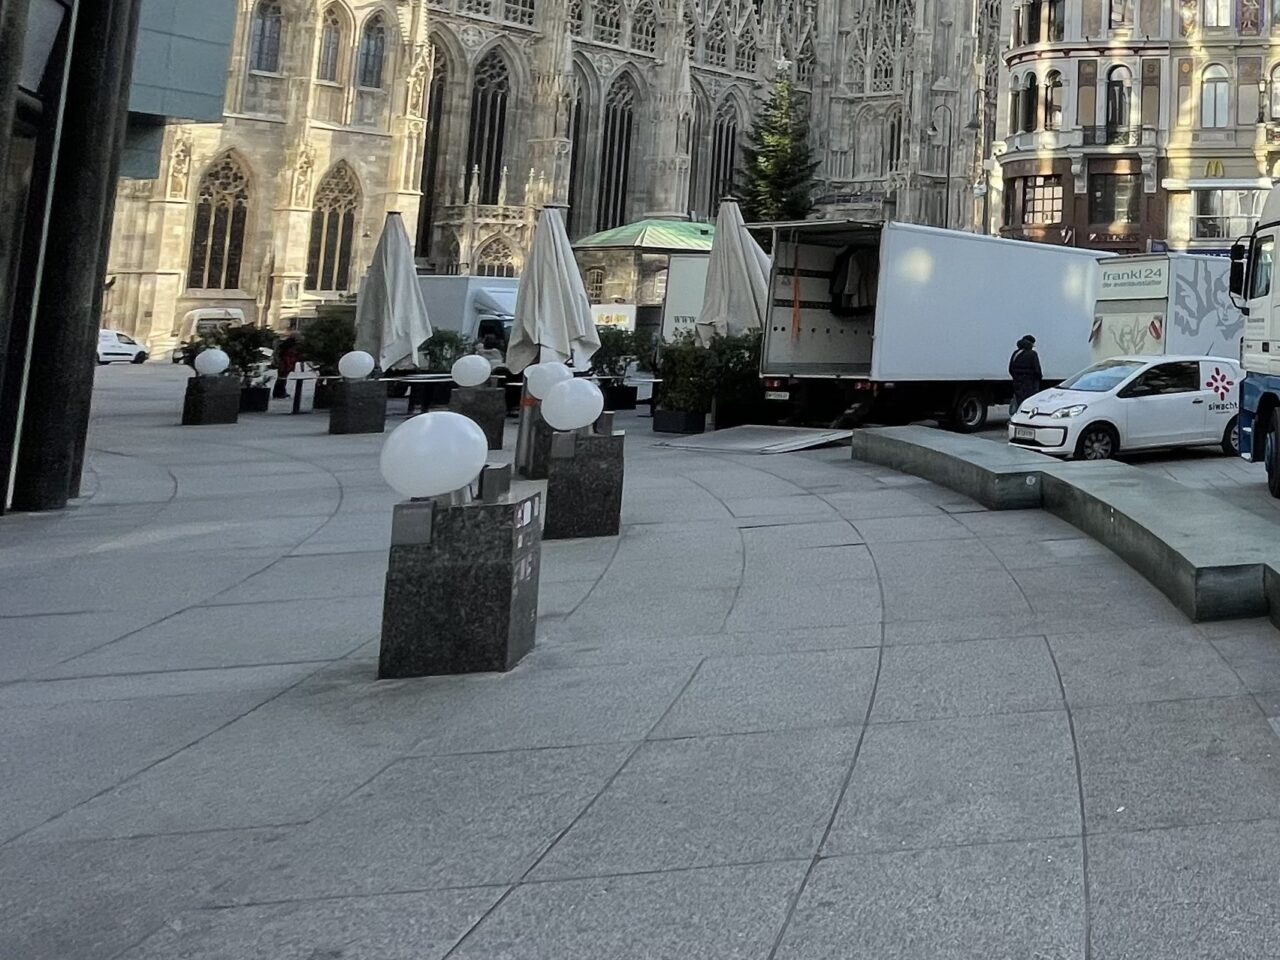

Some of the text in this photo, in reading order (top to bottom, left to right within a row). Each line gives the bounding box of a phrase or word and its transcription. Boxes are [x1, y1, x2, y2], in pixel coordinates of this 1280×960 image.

[1102, 267, 1162, 281] frankl 24
[1208, 401, 1239, 411] siwacht
